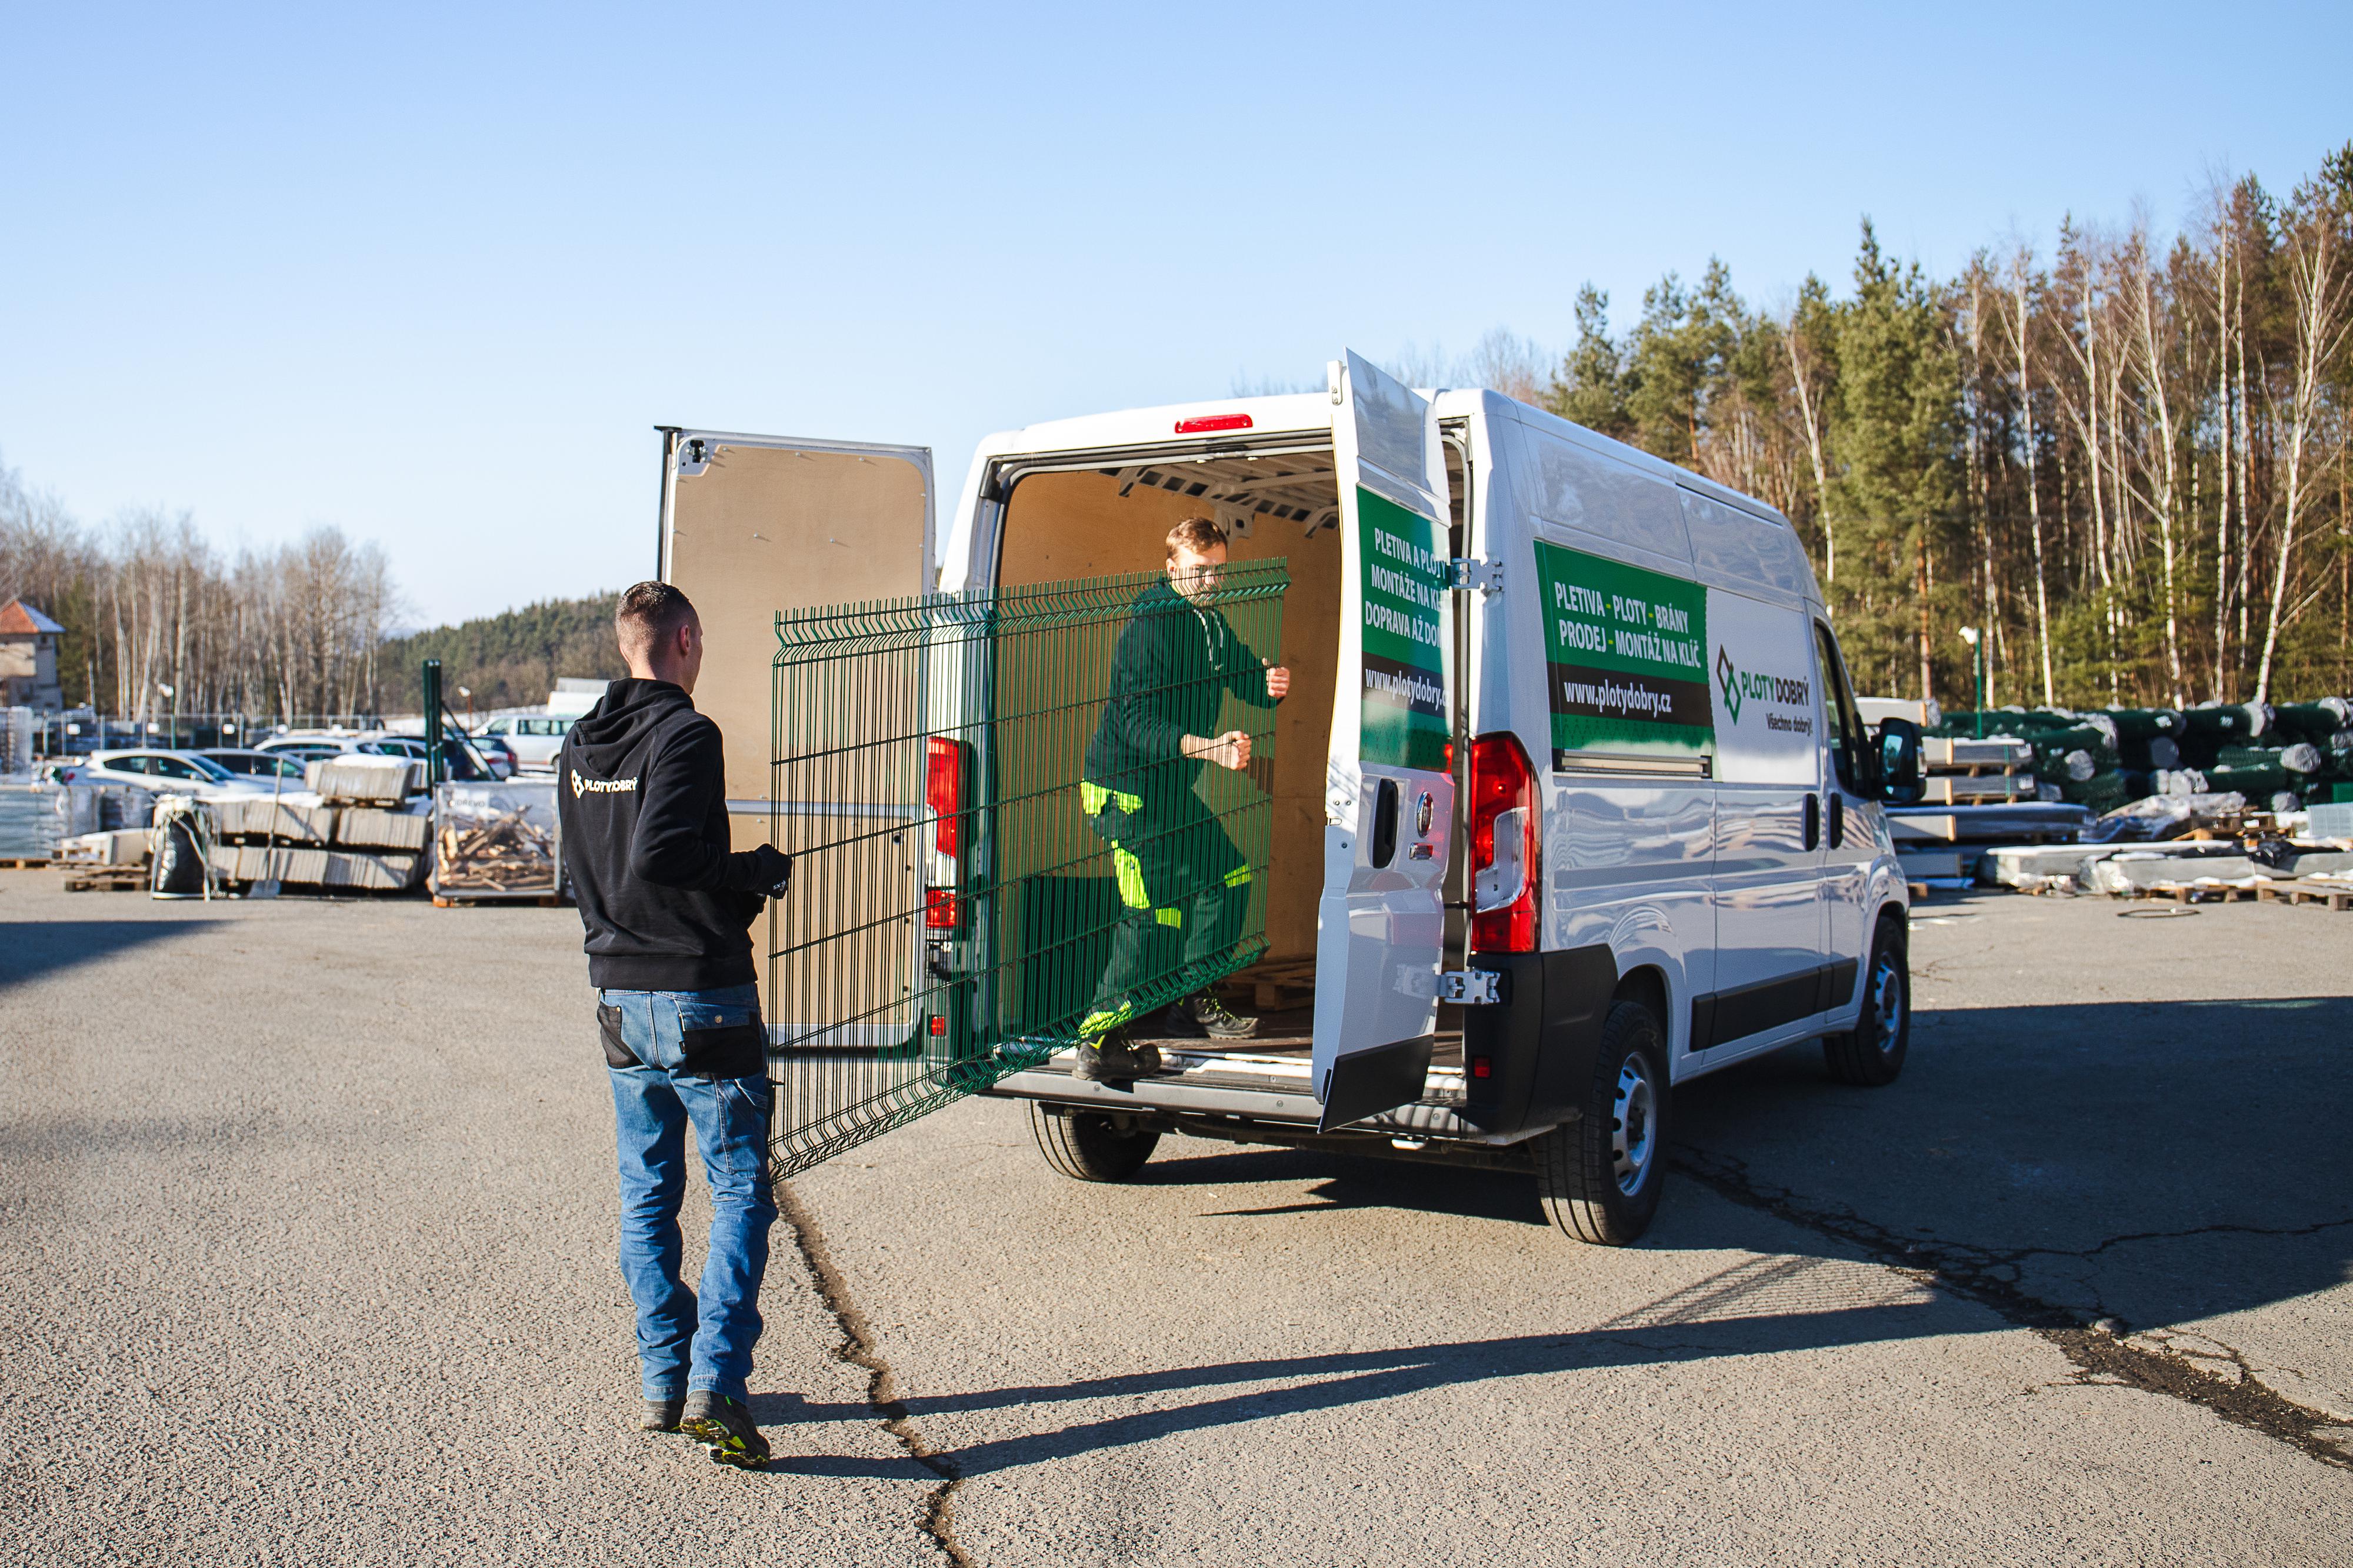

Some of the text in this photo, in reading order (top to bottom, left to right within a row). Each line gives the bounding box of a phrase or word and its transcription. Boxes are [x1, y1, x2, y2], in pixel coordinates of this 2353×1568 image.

[1375, 528, 1445, 579] PLETIVA A PLOTY
[1371, 563, 1415, 602] MONTÁŽE
[1417, 582, 1429, 608] NA
[1555, 582, 1688, 633] PLETIVA PLOTY BRÁNY
[1365, 600, 1410, 638] DOPRAVA
[1412, 615, 1423, 642] AŽ
[1559, 619, 1701, 668] PRODEJ MONTÁŽ NA KLÍČ
[1365, 669, 1450, 710] www.plotydobry.cz
[1564, 679, 1671, 718] www.plotydobry.cz
